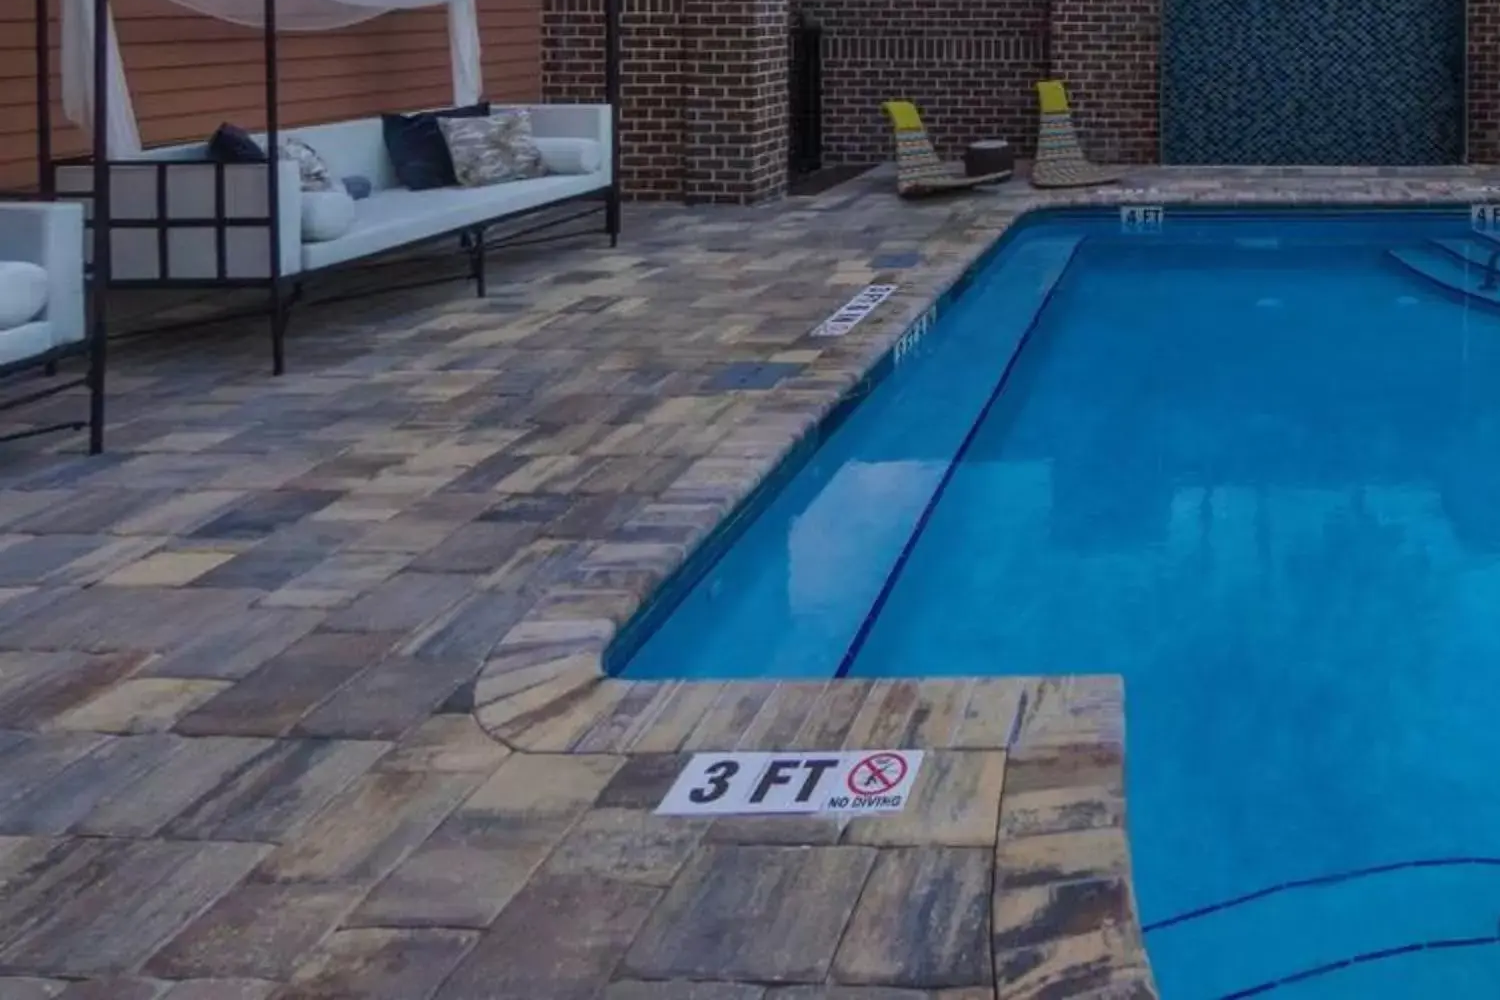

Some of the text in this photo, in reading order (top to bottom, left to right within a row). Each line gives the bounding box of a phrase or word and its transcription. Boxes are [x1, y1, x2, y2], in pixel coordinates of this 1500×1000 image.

[1143, 209, 1161, 225] FT
[688, 759, 841, 804] 3 FT
[828, 795, 902, 809] NO DIVING
